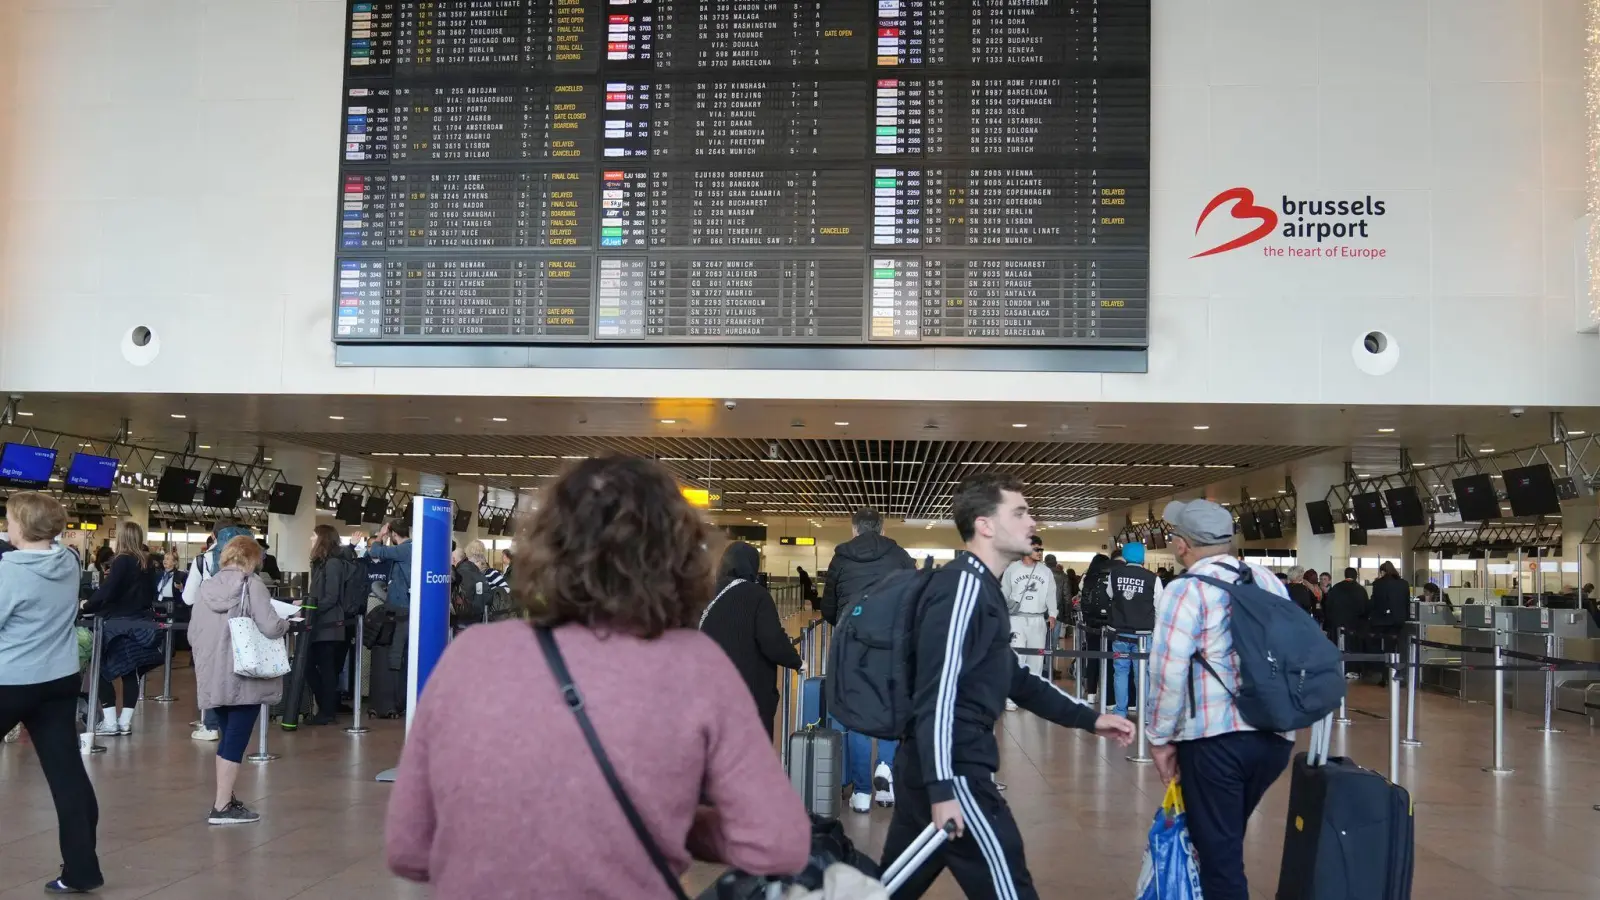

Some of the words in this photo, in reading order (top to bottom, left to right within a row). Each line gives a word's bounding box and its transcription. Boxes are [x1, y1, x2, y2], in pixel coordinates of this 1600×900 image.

[1282, 195, 1386, 216] brussels
[1282, 217, 1369, 242] airport
[1263, 246, 1284, 257] the
[1288, 246, 1322, 257] heart
[1325, 246, 1338, 257] of
[1341, 246, 1387, 259] Europe
[1117, 577, 1144, 586] GUCCI
[1118, 584, 1144, 593] TIGER
